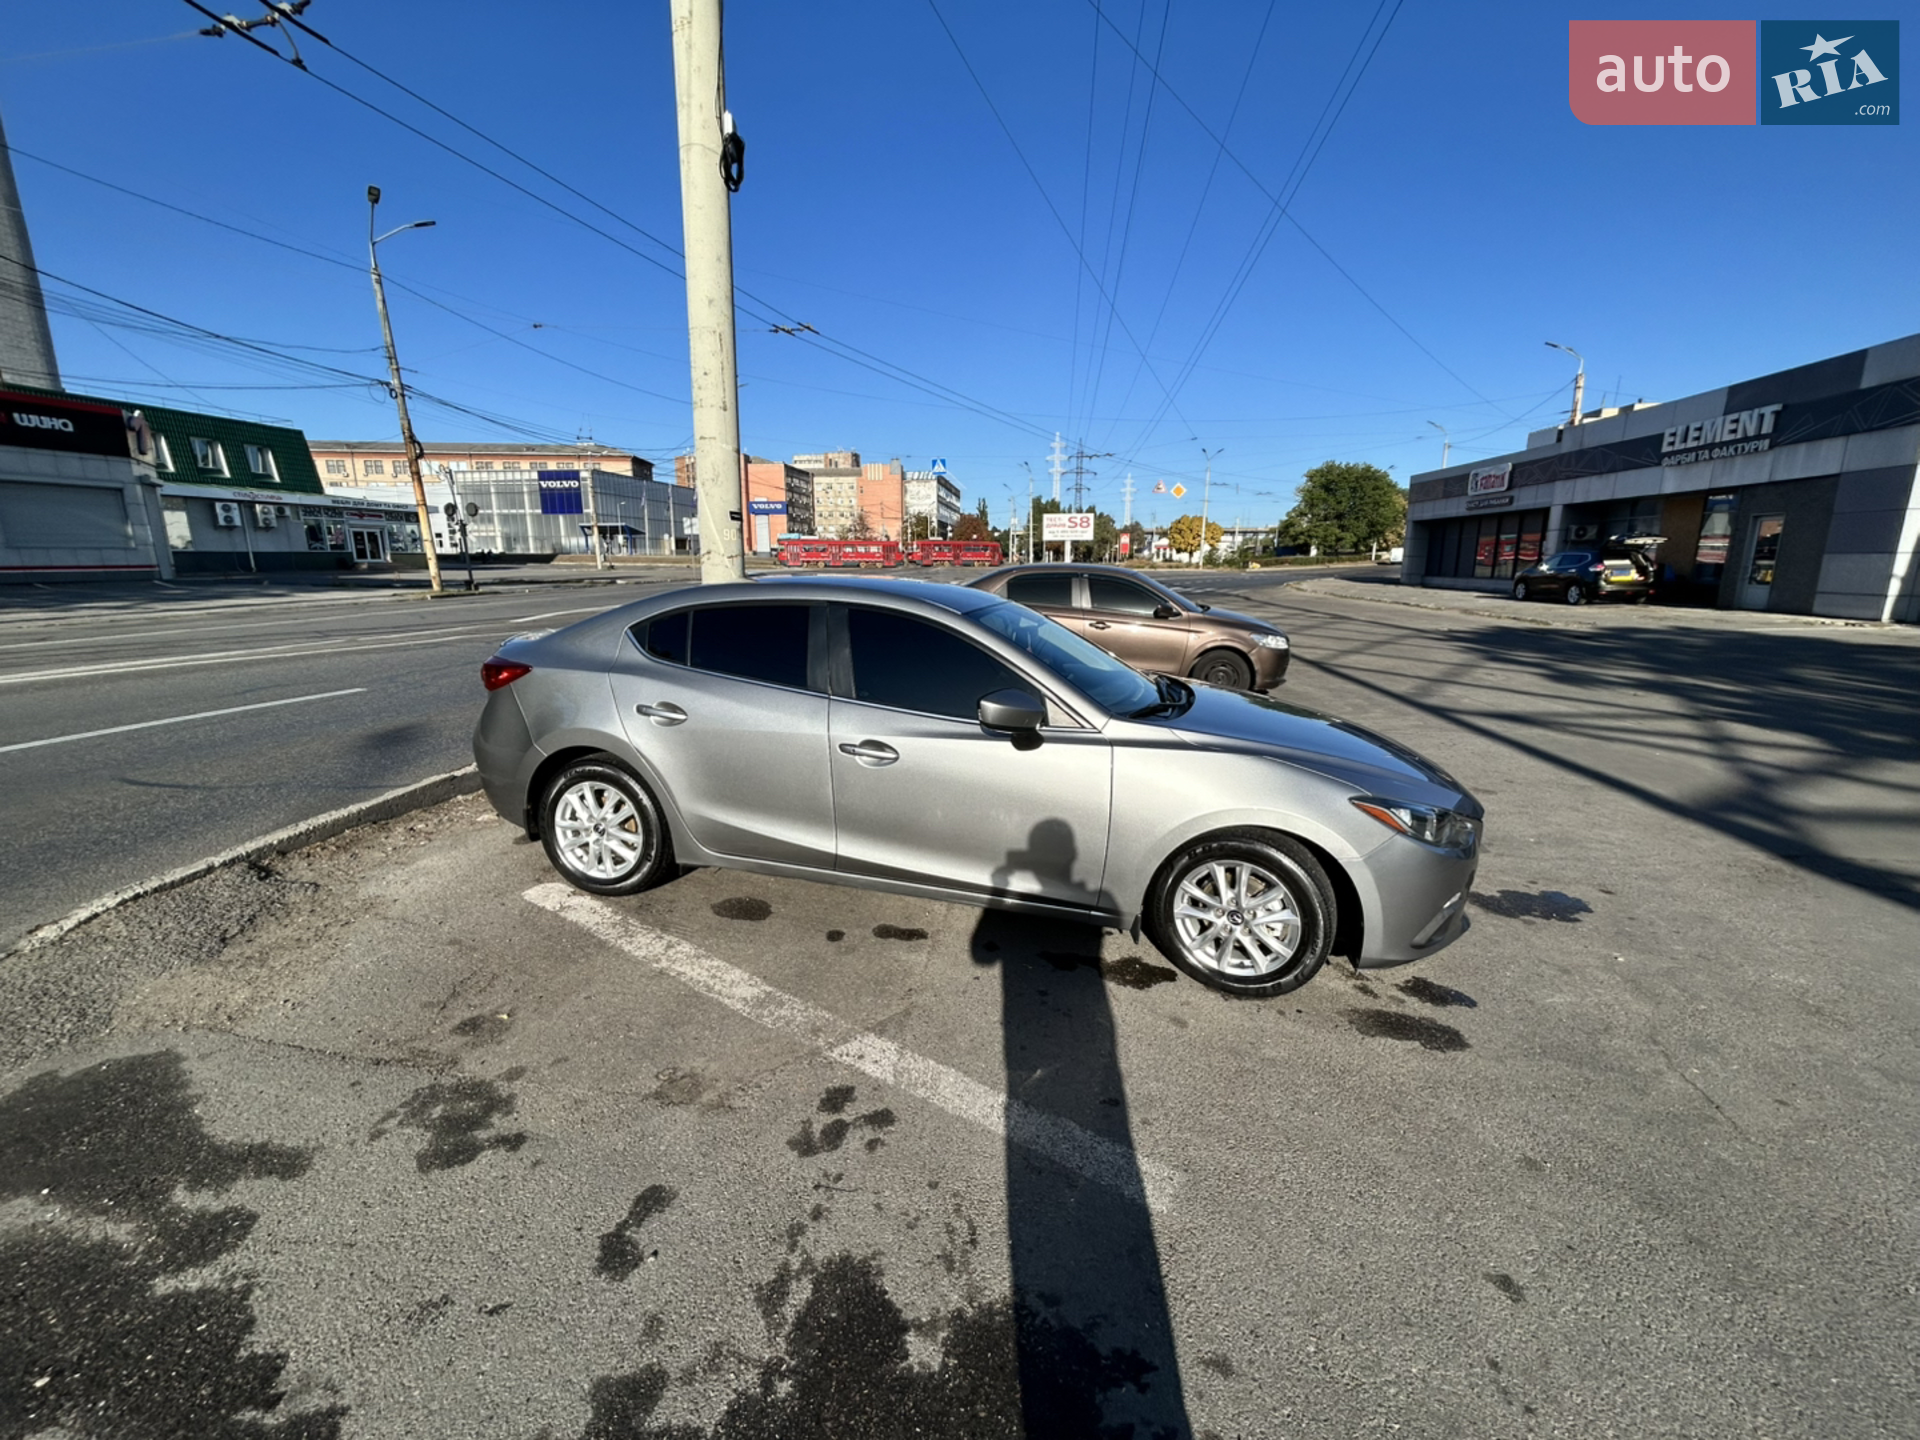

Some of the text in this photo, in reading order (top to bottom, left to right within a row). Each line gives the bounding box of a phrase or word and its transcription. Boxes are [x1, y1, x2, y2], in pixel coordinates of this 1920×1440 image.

[1661, 403, 1784, 453] ELEMENT
[1661, 439, 1771, 467] ФАРБИ ТА ФАКТУРИ
[539, 480, 579, 488] VOLVO
[1068, 516, 1091, 528] S8
[723, 528, 737, 541] 90
